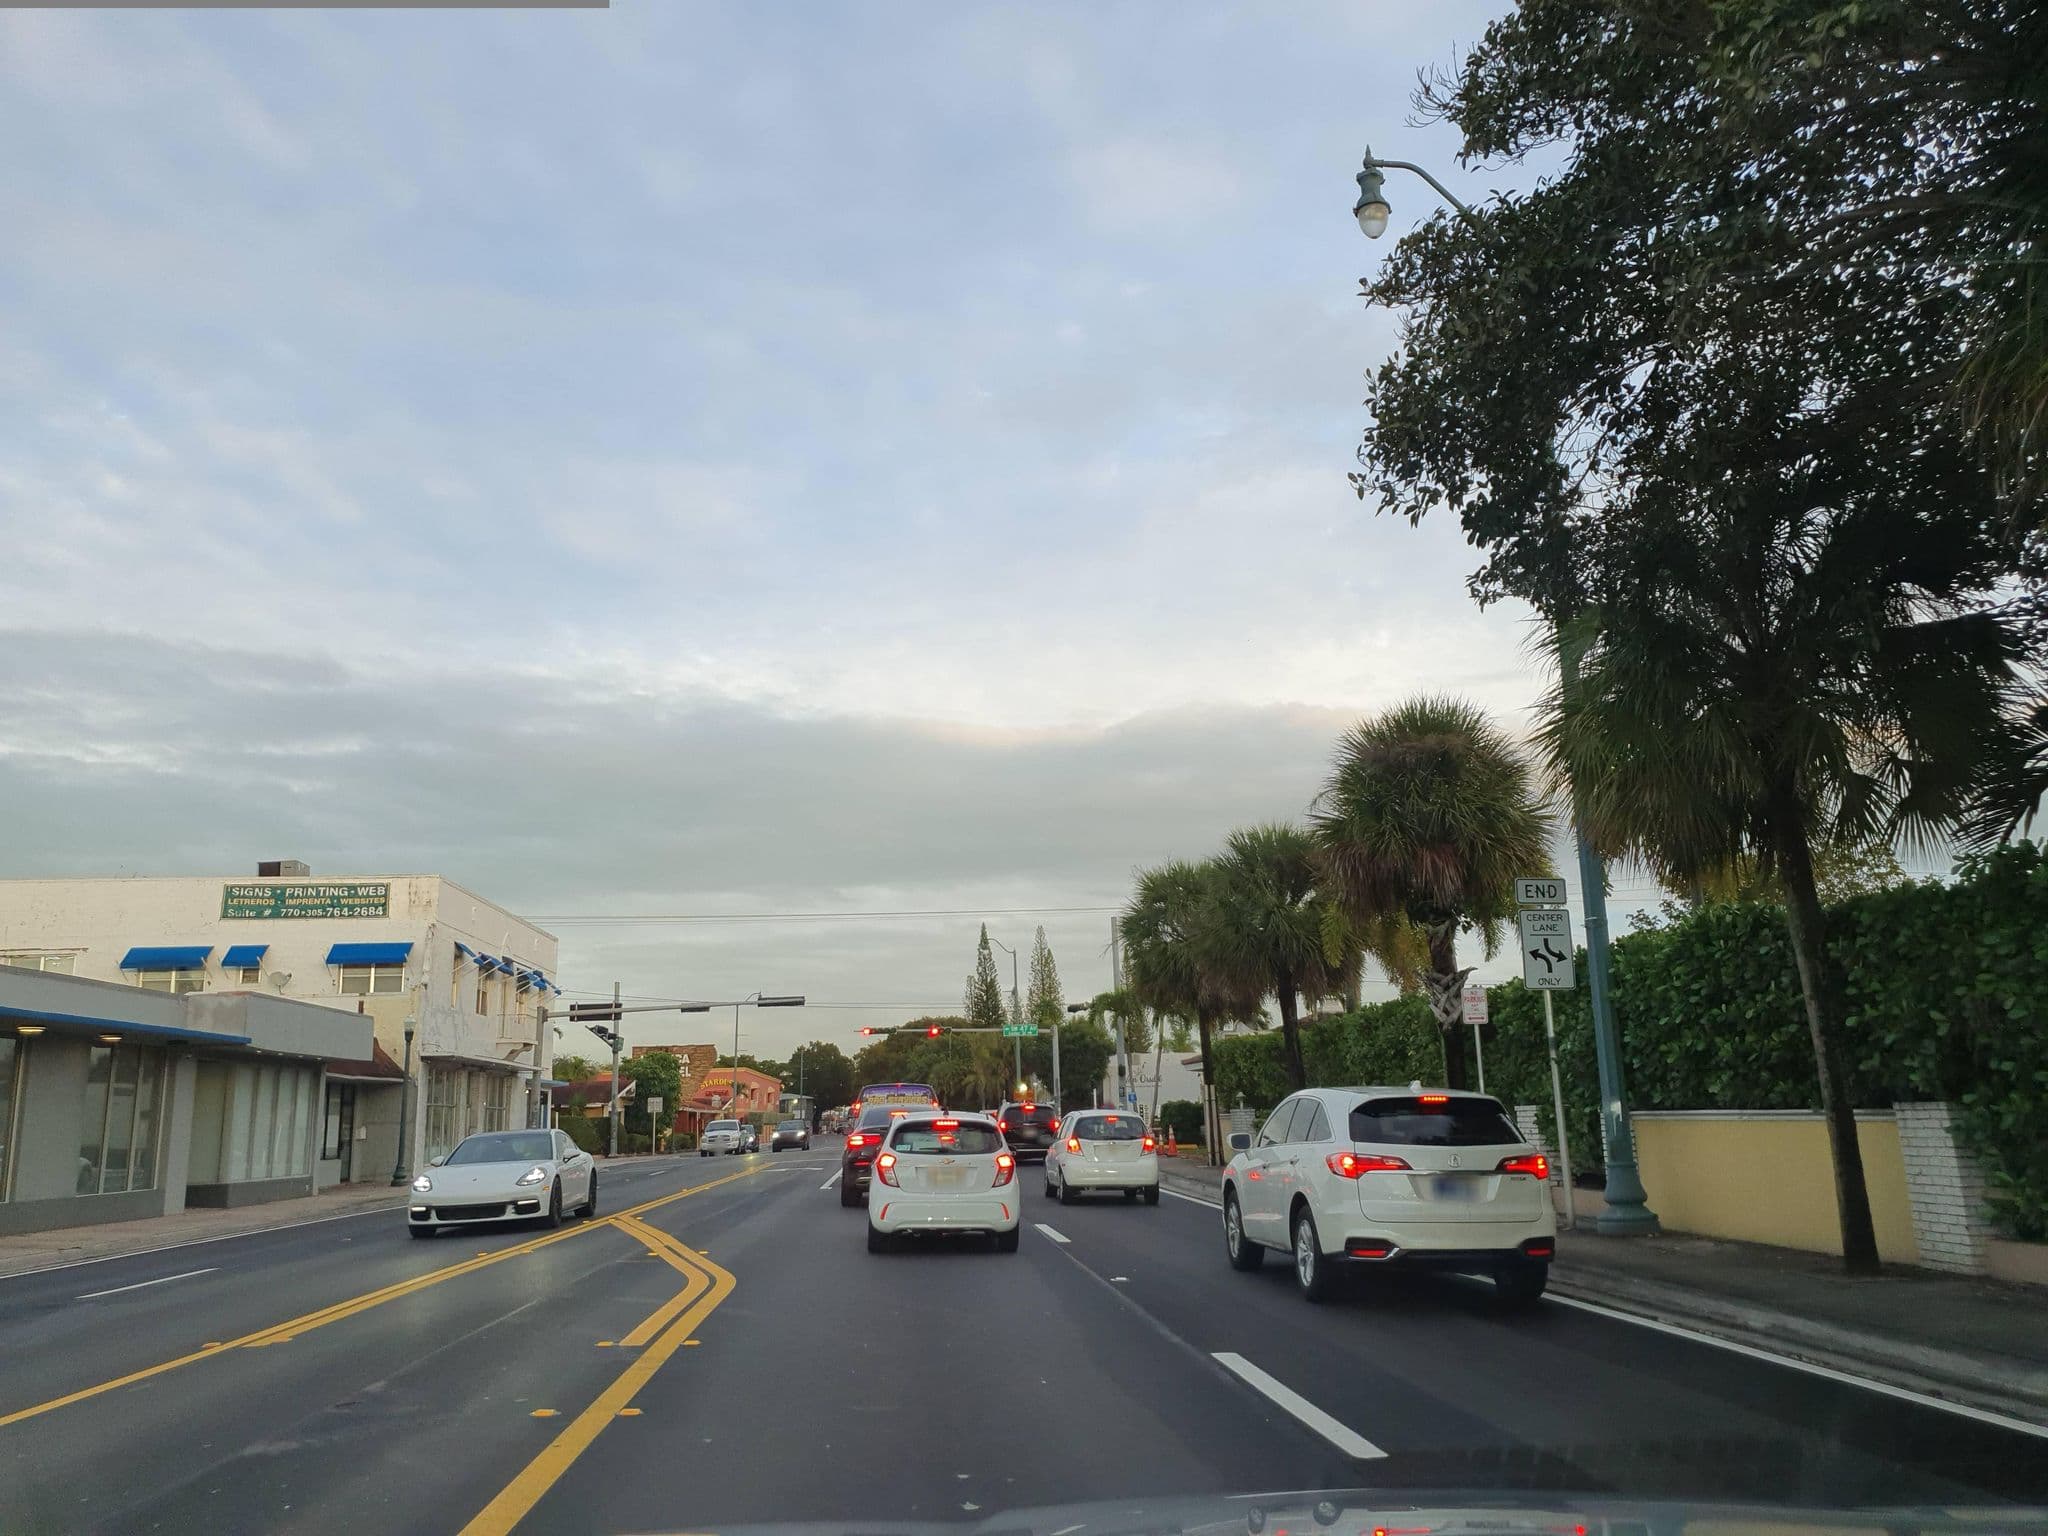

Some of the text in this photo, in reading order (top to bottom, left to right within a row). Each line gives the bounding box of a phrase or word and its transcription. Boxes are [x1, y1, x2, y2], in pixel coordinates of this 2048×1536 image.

[231, 886, 386, 897] SIGNS PRINTING WEB
[1525, 884, 1557, 899] END
[228, 896, 385, 906] LETREROS IMPRENTA WEBSITES
[227, 908, 256, 917] Suite
[1526, 913, 1563, 922] CENTER
[1532, 924, 1559, 932] LANE
[1537, 977, 1562, 986] ONLY
